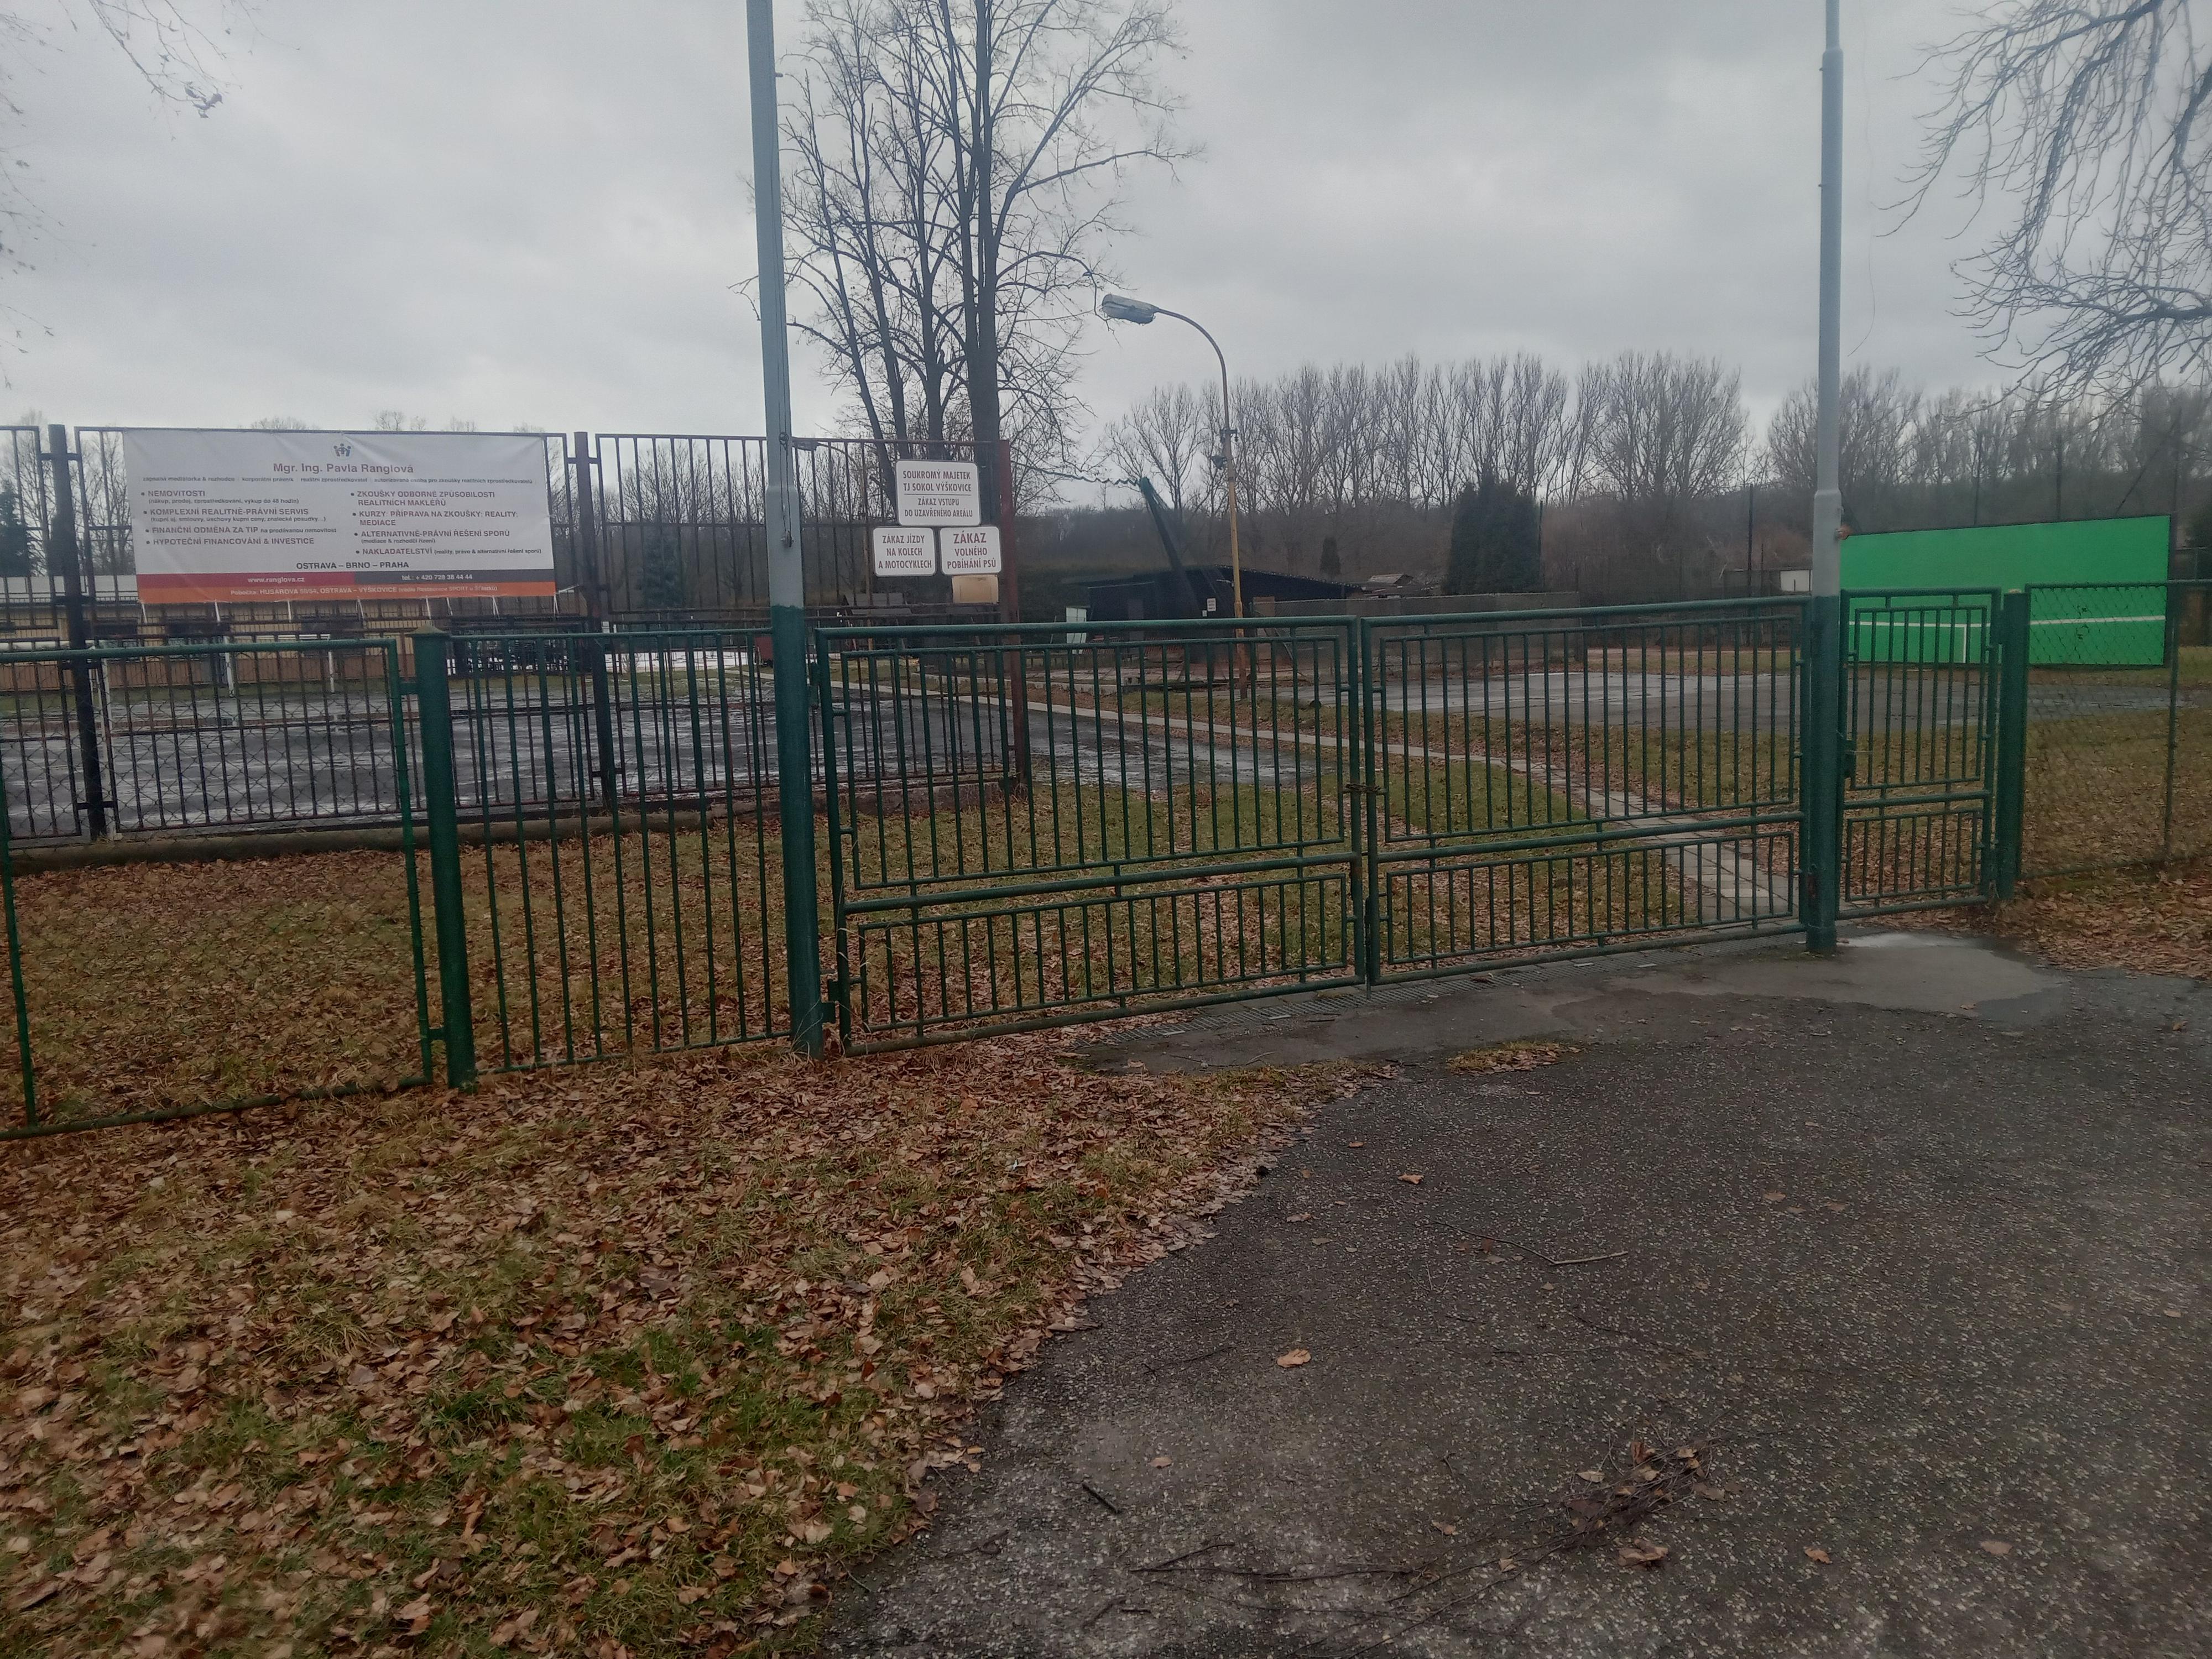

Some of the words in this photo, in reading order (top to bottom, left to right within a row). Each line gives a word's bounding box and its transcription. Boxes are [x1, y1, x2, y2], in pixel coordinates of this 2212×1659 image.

[273, 463, 298, 474] Mgr.
[301, 463, 322, 474] Ing.
[326, 463, 357, 472] Pavla
[361, 463, 414, 474] Ranglová
[903, 469, 941, 479] SOUKROMÝ
[943, 471, 971, 480] MAJETEK
[903, 483, 910, 492] TJ
[912, 483, 934, 492] SOKOL
[936, 481, 972, 492] VÝŠKOVICE
[917, 496, 937, 506] ZÁKAZ
[905, 509, 912, 517] DO
[914, 507, 951, 517] UZAVŘENÉHO
[953, 508, 973, 518] AREÁLU
[453, 529, 482, 537] ŘEŠENÍ
[882, 533, 905, 544] ZÁKAZ
[906, 533, 925, 544] JÍZDY
[953, 530, 987, 544] ZÁKAZ
[886, 547, 896, 556] NA
[898, 547, 922, 556] KOLECH
[954, 545, 988, 556] VOLNÉHO
[878, 560, 884, 569] A
[885, 560, 932, 569] MOTOCYKLECH
[947, 557, 982, 569] POBÍHÁNÍ
[983, 557, 997, 568] PSŮ
